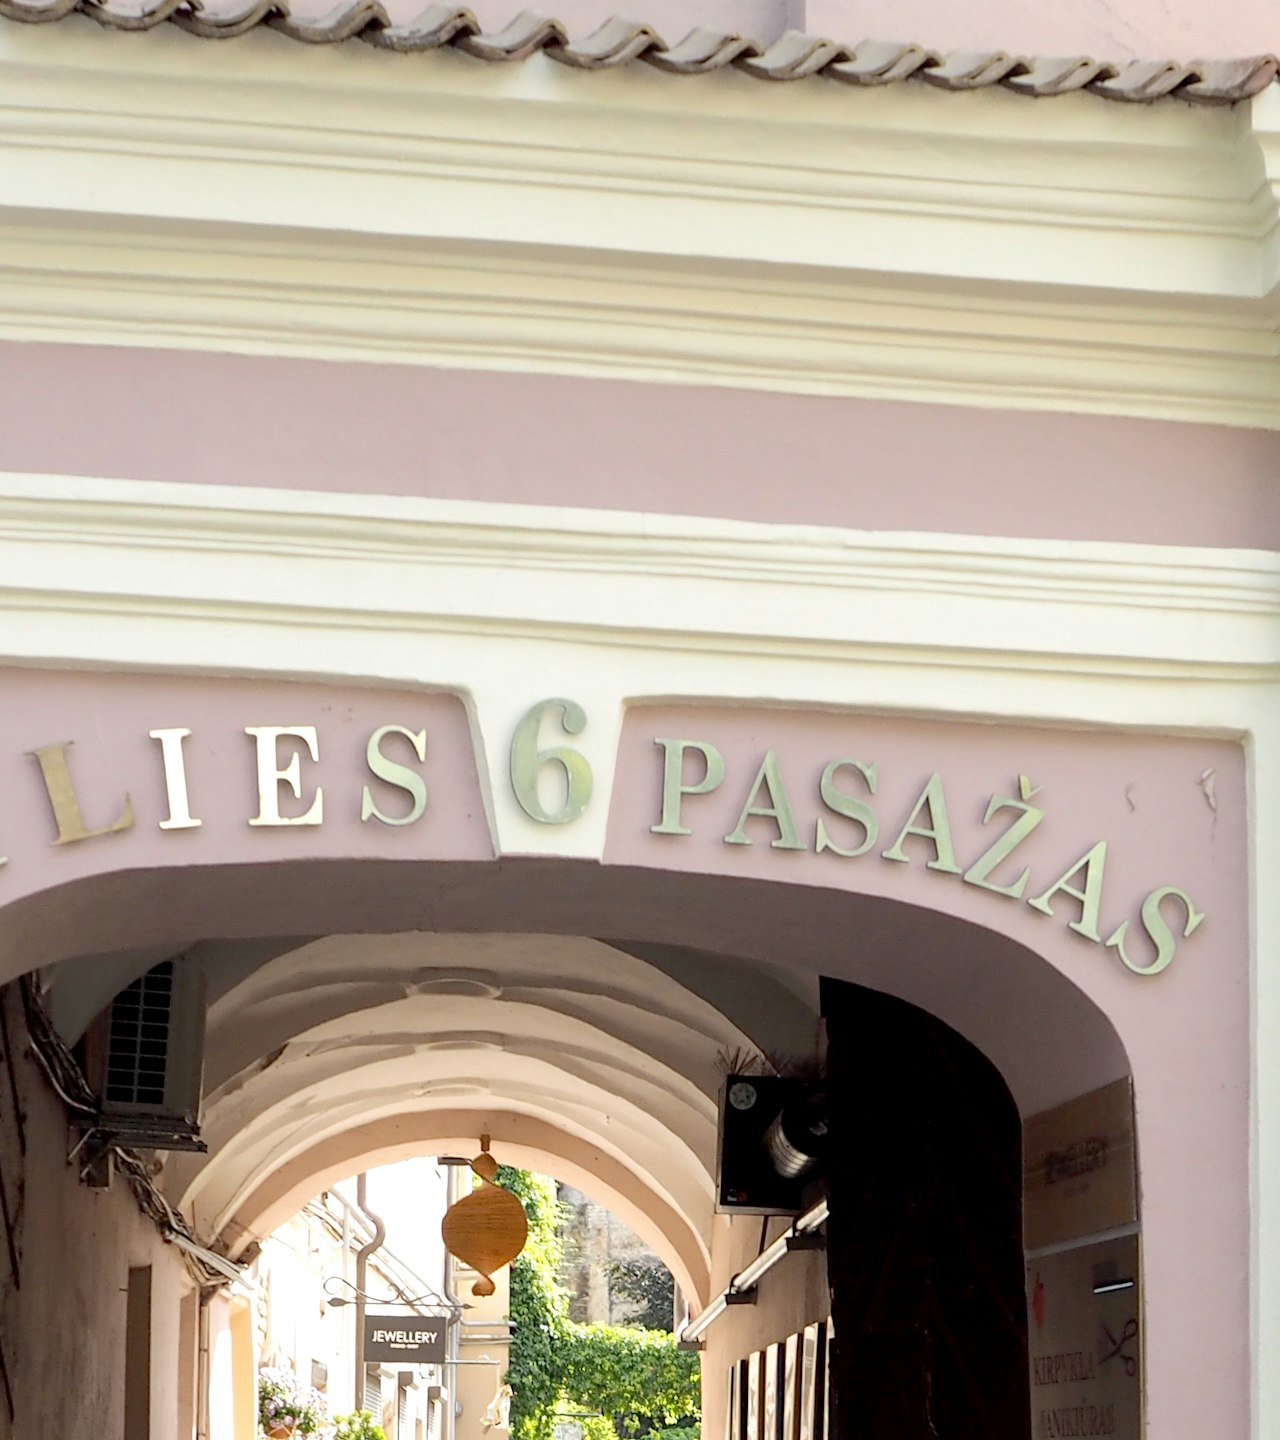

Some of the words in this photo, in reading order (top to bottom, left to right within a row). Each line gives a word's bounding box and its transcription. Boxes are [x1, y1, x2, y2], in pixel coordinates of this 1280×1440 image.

[509, 698, 594, 825] 6
[649, 736, 1205, 977] PASAŽAS
[372, 1330, 438, 1344] JEWELLERY
